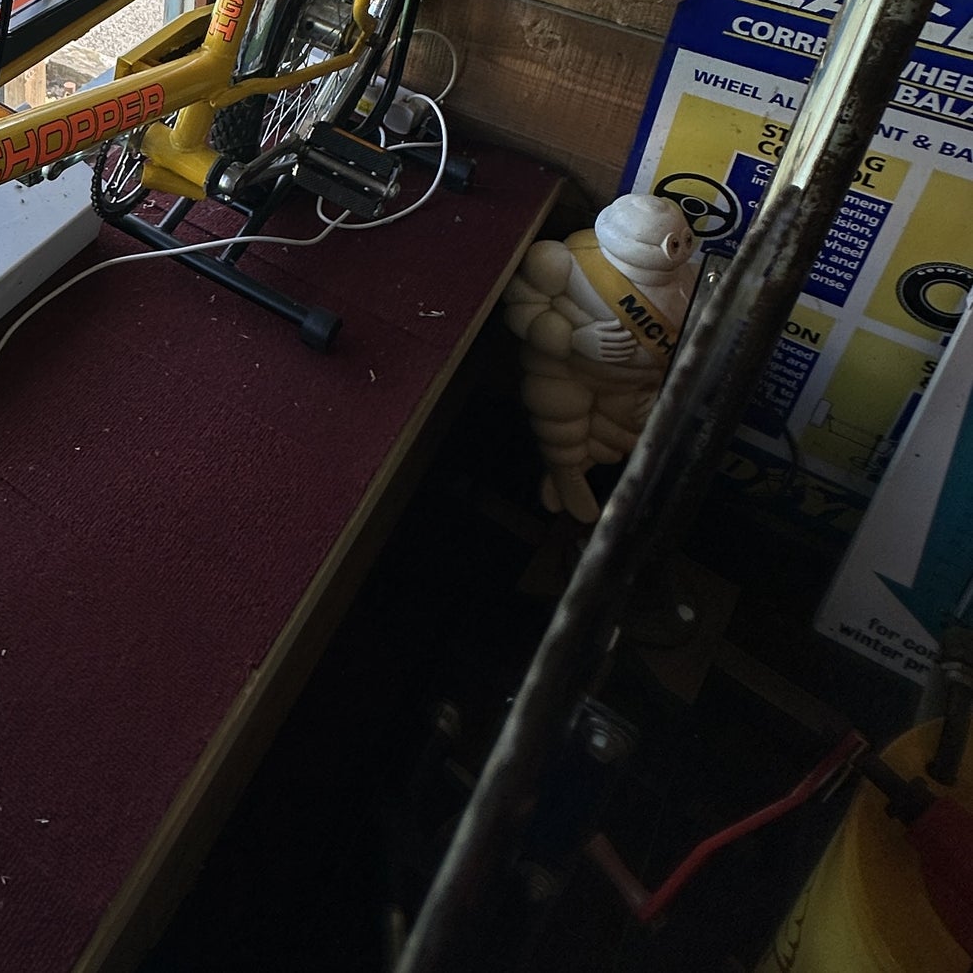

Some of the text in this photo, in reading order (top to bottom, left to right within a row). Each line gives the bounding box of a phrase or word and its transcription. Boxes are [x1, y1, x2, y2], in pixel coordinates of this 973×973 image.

[732, 16, 828, 55] CORRE
[694, 69, 762, 100] WHEEL
[912, 134, 932, 150] &
[844, 194, 887, 214] ment
[833, 216, 874, 237] ision,
[839, 207, 881, 227] ering
[828, 228, 869, 249] ncing
[829, 254, 860, 270] and
[810, 272, 847, 291] onse.
[618, 293, 676, 354] MICH
[785, 321, 821, 344] ON
[868, 617, 900, 639] for
[839, 622, 931, 673] winter pr
